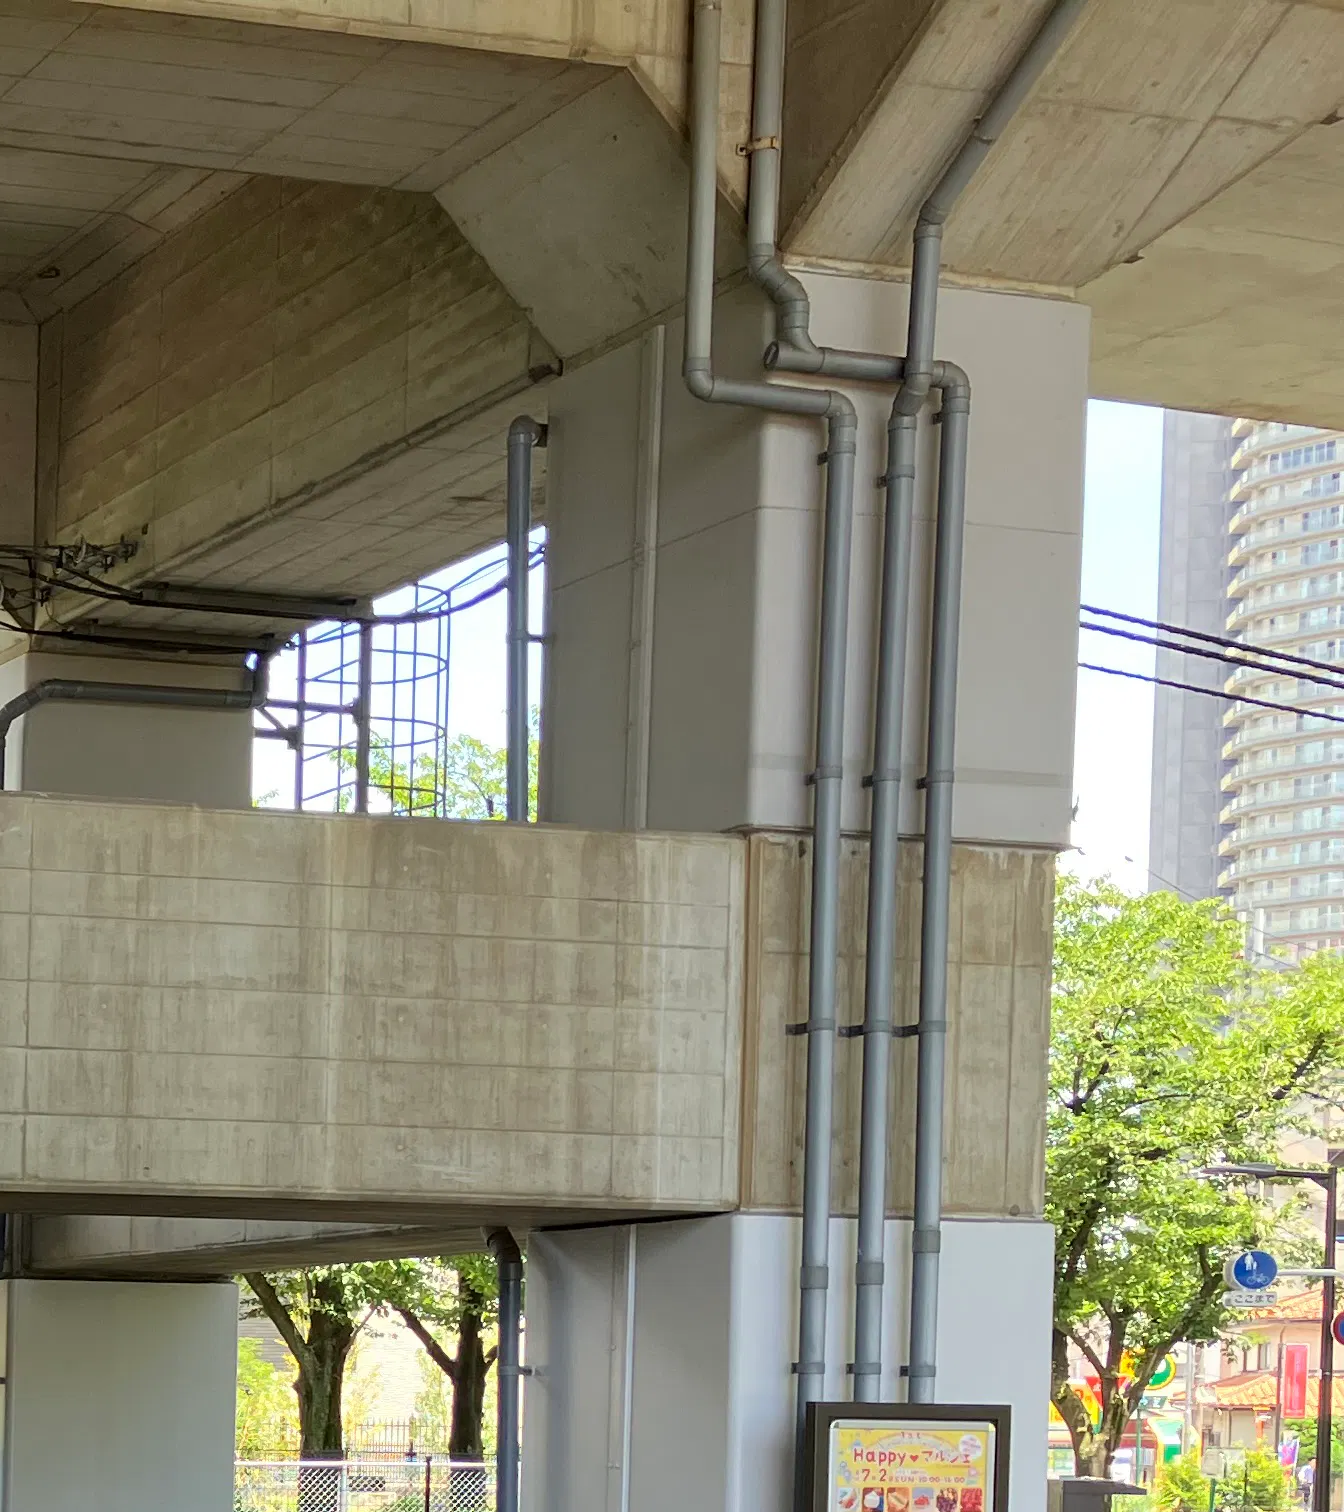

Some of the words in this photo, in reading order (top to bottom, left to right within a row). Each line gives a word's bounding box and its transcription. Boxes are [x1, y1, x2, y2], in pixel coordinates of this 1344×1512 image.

[1234, 1294, 1275, 1304] ここまで
[853, 1448, 907, 1466] Happy
